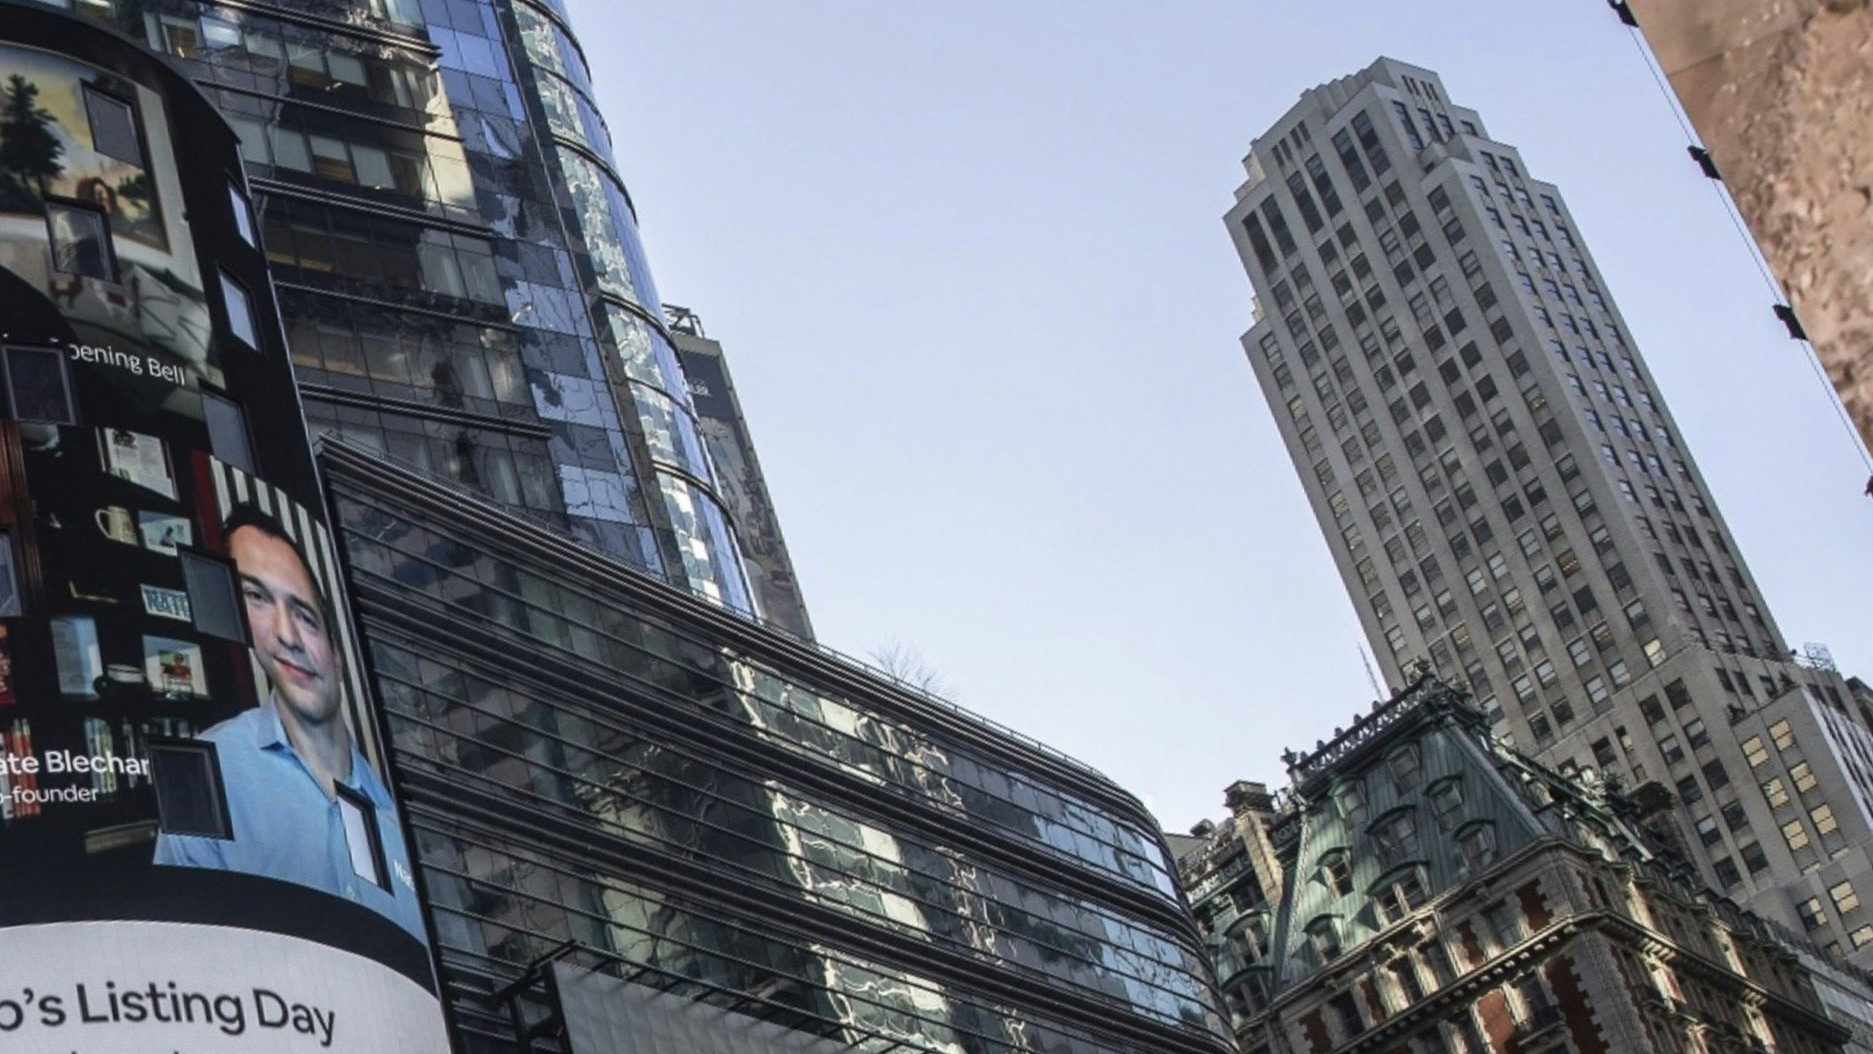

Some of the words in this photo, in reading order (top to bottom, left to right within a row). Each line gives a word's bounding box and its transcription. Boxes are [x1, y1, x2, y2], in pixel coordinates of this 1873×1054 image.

[147, 356, 186, 386] Bell
[75, 981, 246, 1036] Listing
[253, 988, 336, 1048] Day
